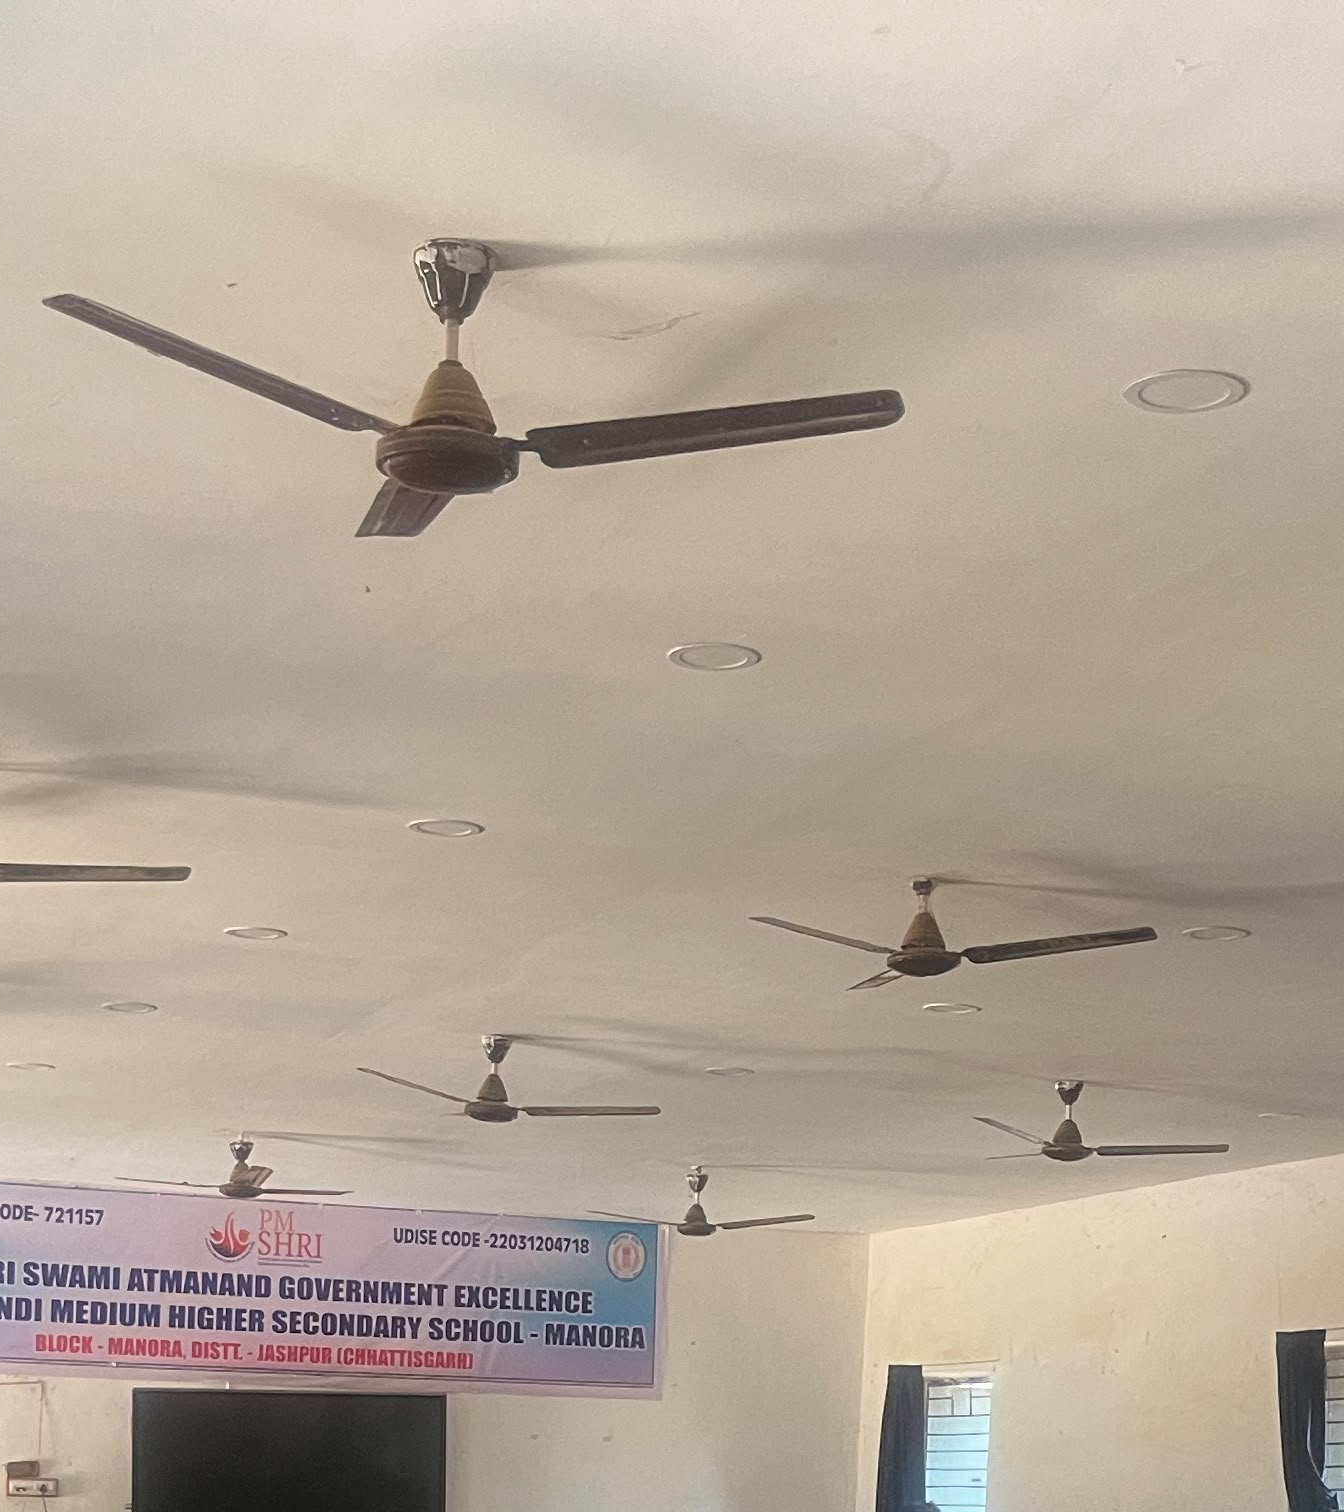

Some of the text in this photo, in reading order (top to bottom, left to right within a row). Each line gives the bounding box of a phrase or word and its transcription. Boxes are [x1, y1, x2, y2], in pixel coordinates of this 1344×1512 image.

[44, 1206, 104, 1226] 721157
[259, 1208, 294, 1232] PM
[257, 1230, 322, 1258] SHRI
[393, 1227, 437, 1245] UDISE
[441, 1230, 481, 1248] CODE
[23, 1261, 120, 1290] SWAMI
[127, 1267, 272, 1299] ATMANAND
[278, 1275, 448, 1307] GOVERNMENT
[454, 1285, 593, 1314] EXCELLENCE
[50, 1299, 161, 1328] MEDIUM
[168, 1305, 265, 1333] HIGHER
[271, 1309, 422, 1340] SECONDARY
[428, 1317, 524, 1344] SCHOOL
[544, 1323, 646, 1349] MANORA
[35, 1334, 93, 1354] BLOCK
[107, 1337, 187, 1360] MANORA,
[191, 1341, 244, 1361] DISTT.
[257, 1344, 332, 1365] JASHPUR
[337, 1347, 474, 1370] (CHHATTISGARH)
